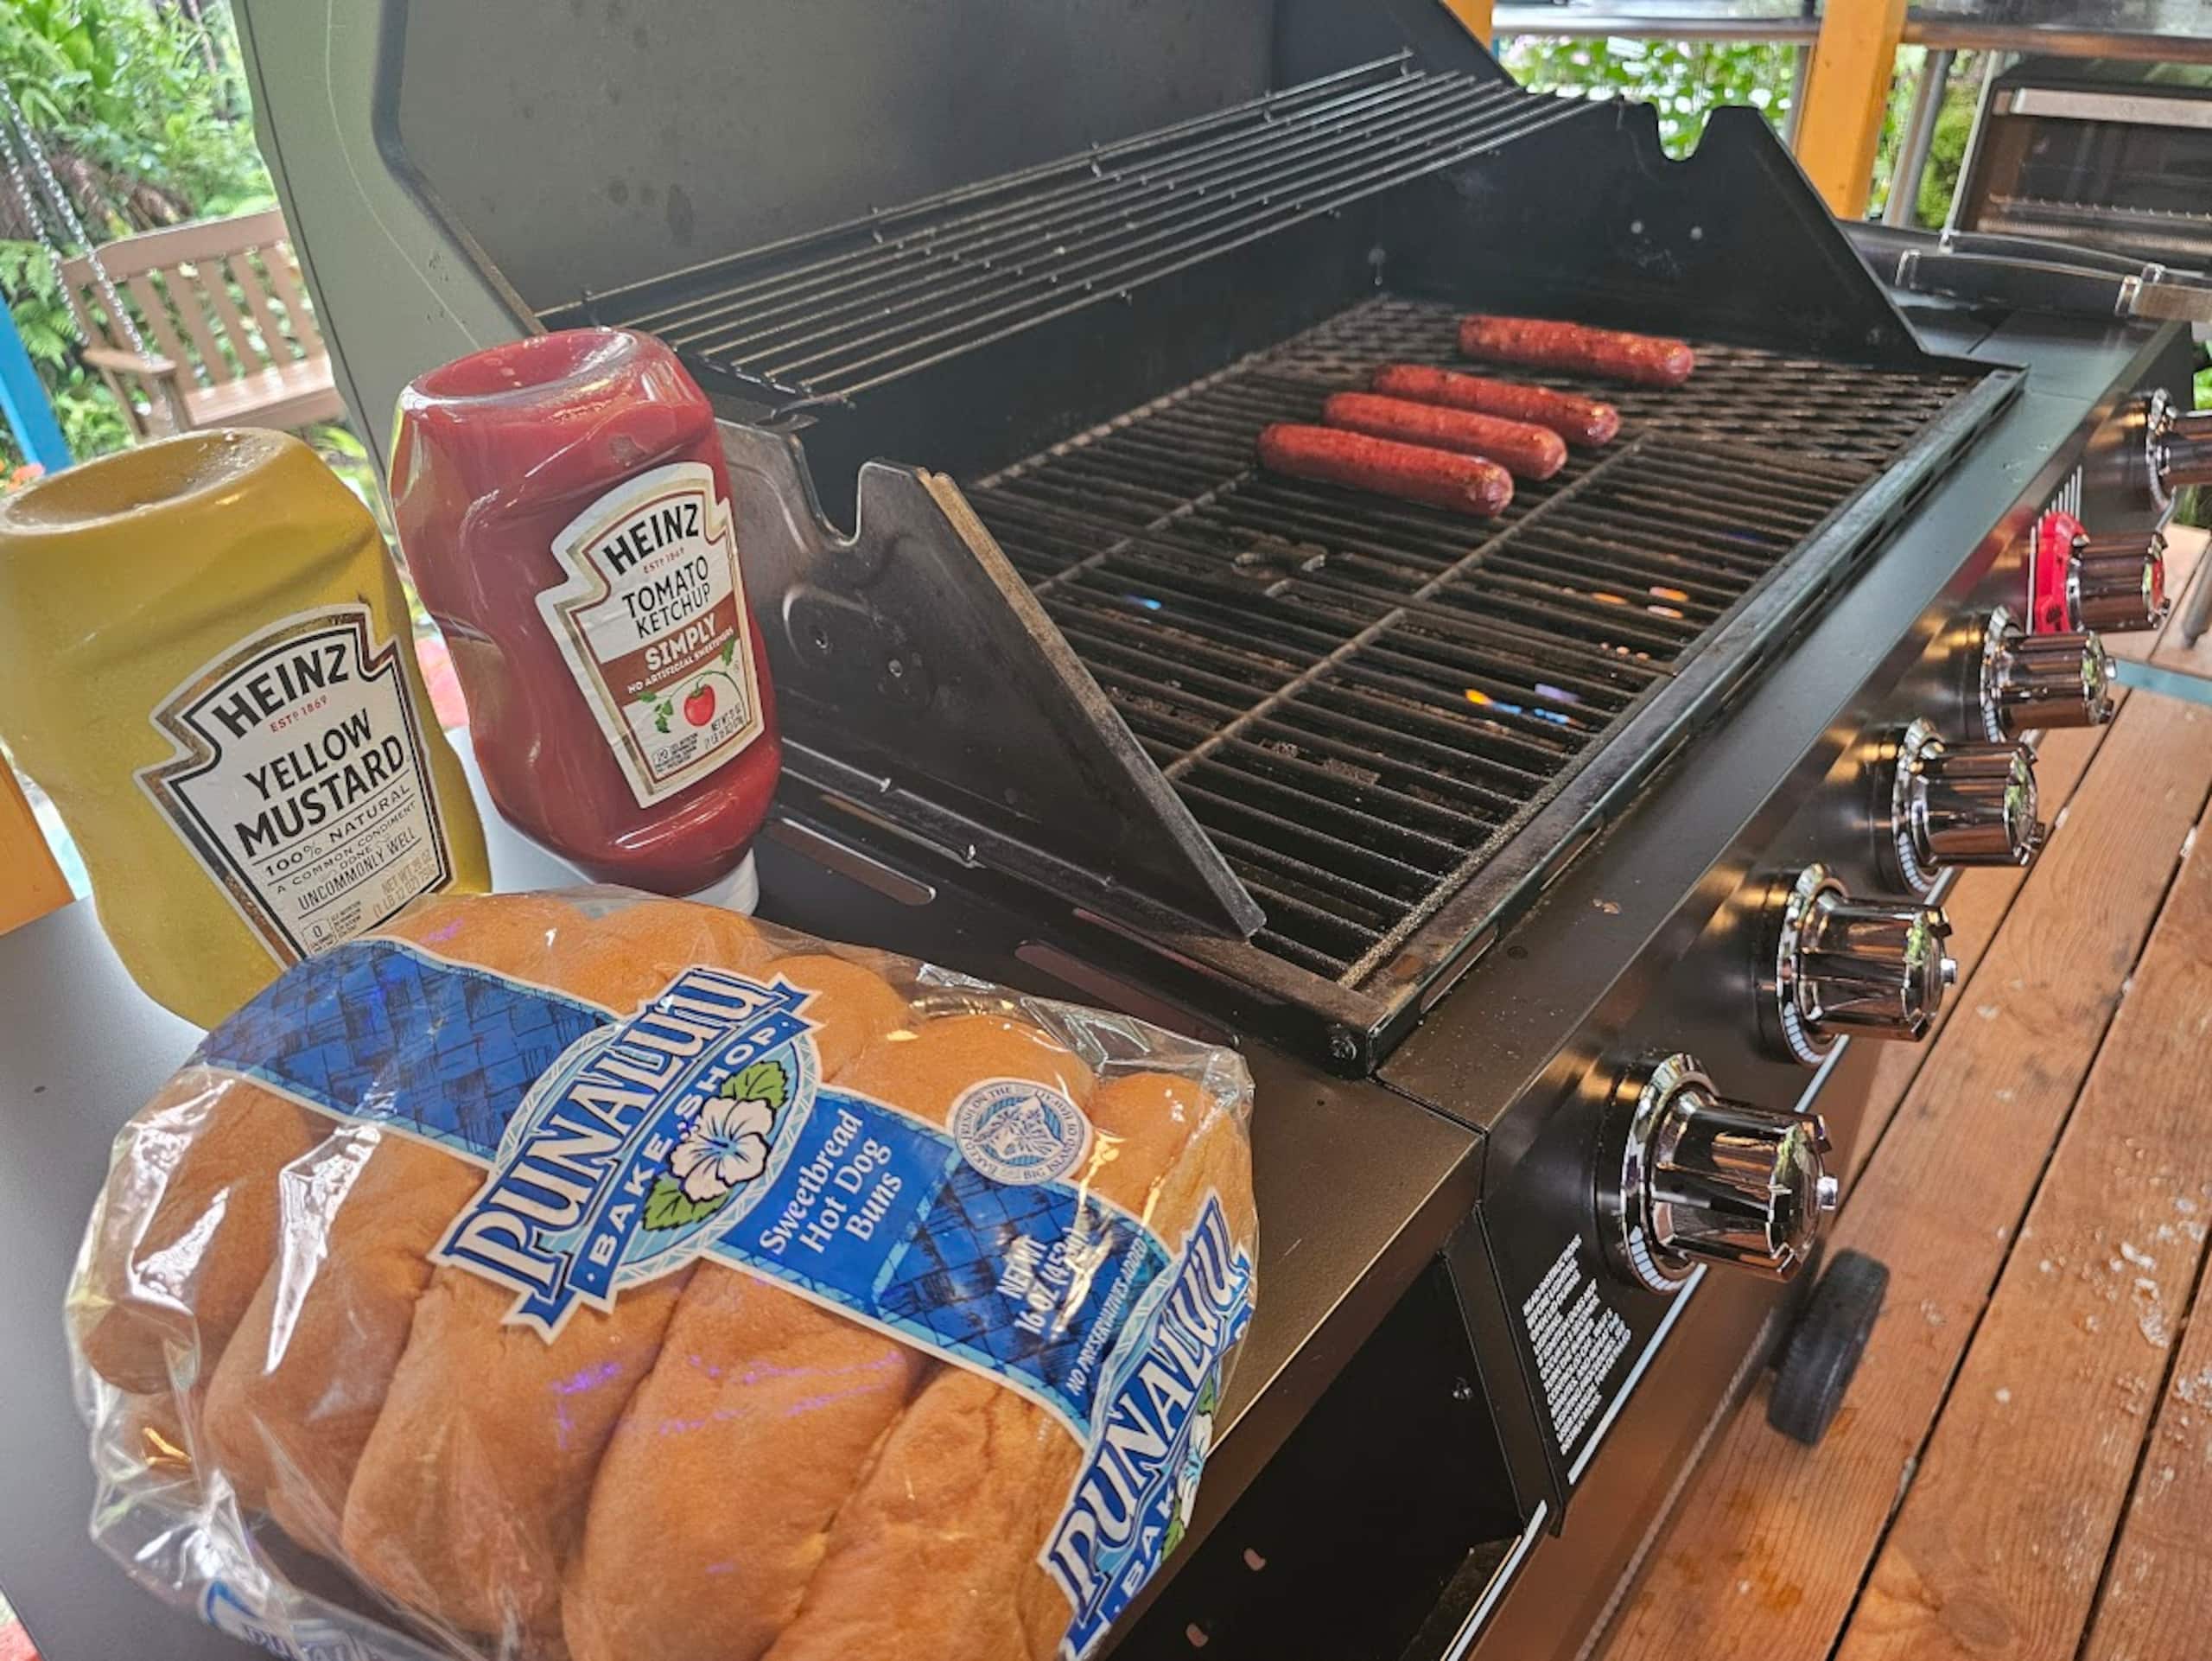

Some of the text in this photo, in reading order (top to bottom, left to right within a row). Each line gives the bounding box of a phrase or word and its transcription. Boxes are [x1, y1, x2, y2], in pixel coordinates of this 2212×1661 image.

[601, 502, 699, 576] HEINZ
[622, 555, 709, 619] TOMATO
[635, 582, 710, 639] KETCHUP
[627, 681, 644, 694] NO
[645, 657, 694, 687] ARTIFICIAL
[645, 613, 715, 671] SIMPLY
[212, 644, 348, 739] HEINZ
[302, 695, 330, 716] 1869
[243, 708, 372, 801] YELLOW
[235, 735, 404, 858] MUSTARD
[265, 784, 410, 876] 100% NATURAL
[276, 800, 416, 895] A COMMON CONDIMENT
[297, 849, 385, 911] UNCOMMONLY
[385, 826, 416, 856] WELL
[340, 843, 372, 870] DONE
[588, 1027, 777, 1268] BAKE SHOP
[760, 1108, 863, 1255] Sweetbread
[798, 1137, 892, 1253] Hot Dog
[844, 1172, 903, 1241] Buns
[996, 1234, 1047, 1300] NET WT
[1027, 1282, 1061, 1312] OZ
[1014, 1310, 1046, 1335] 16
[1065, 1237, 1148, 1397] NO PRESERVATIVES ADDED
